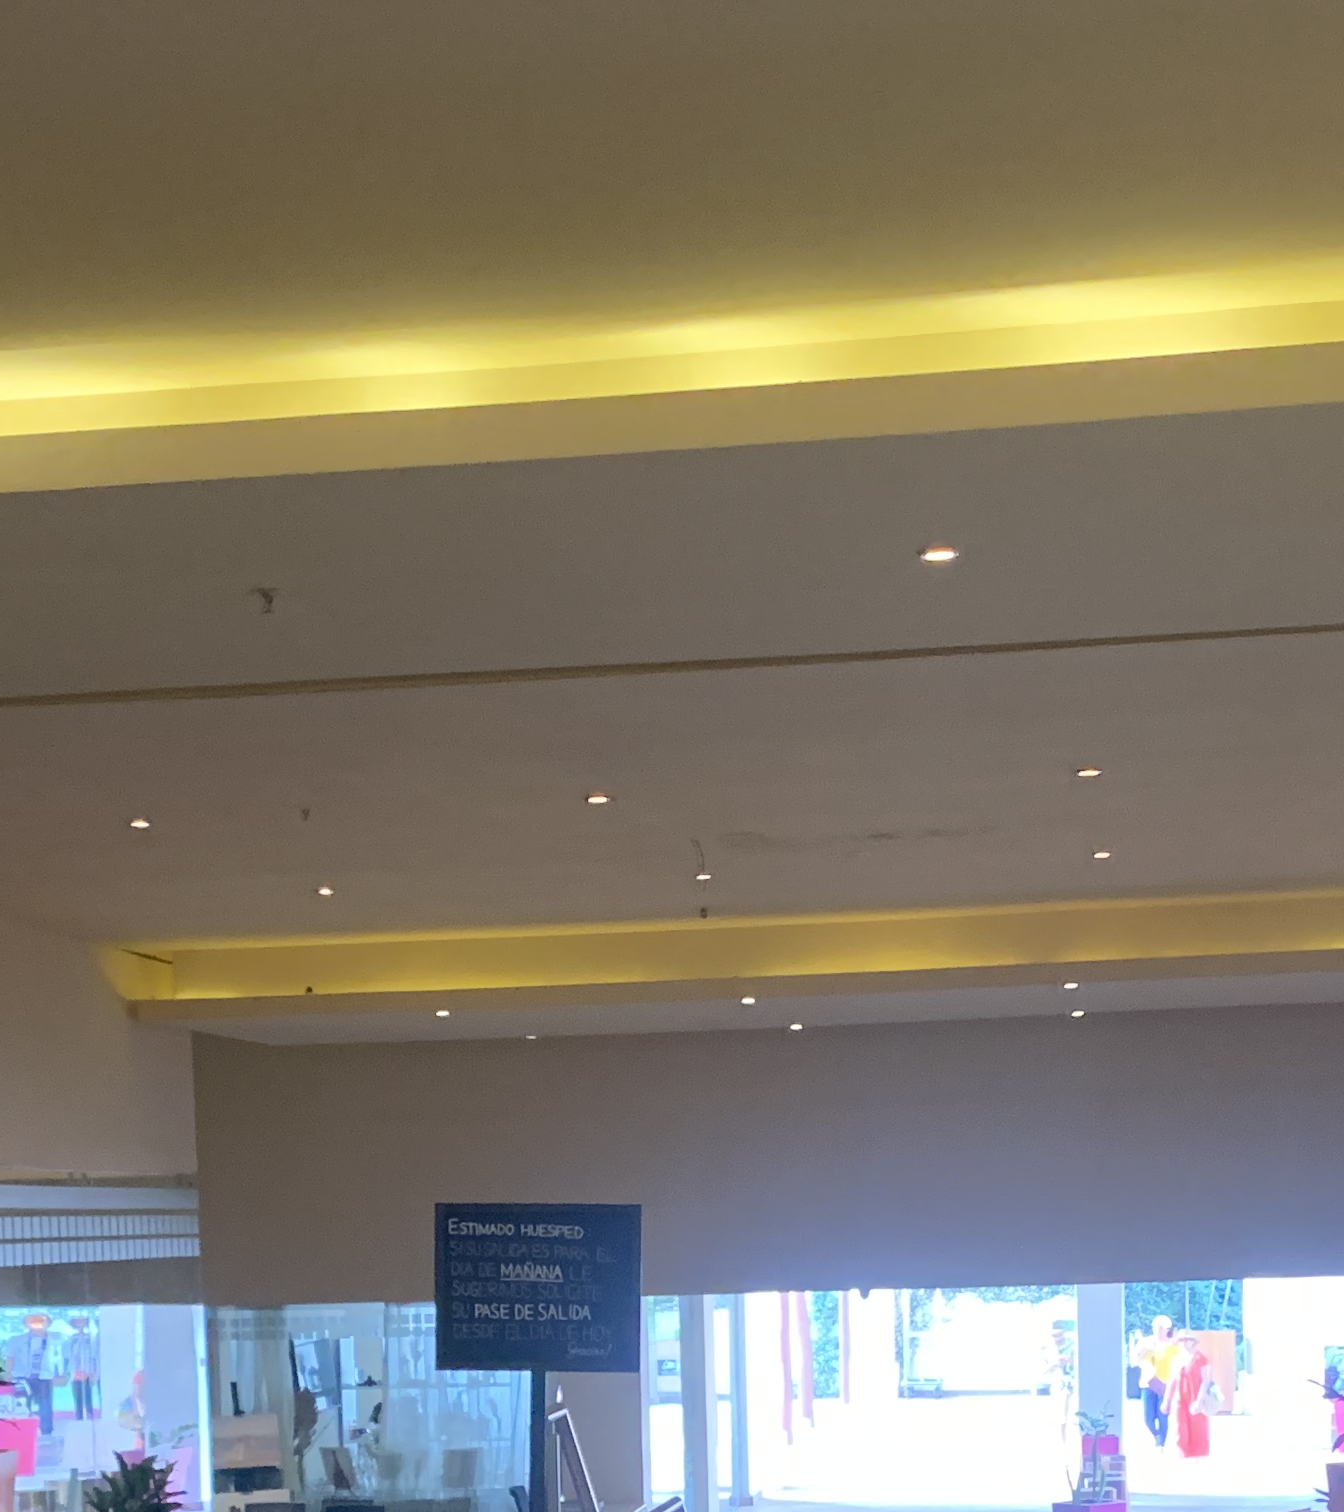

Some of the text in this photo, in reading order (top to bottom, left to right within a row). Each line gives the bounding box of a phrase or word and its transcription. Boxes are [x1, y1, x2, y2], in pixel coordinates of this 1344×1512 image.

[448, 1218, 585, 1239] ESTIMADO HUESPED
[531, 1243, 550, 1258] ES
[554, 1244, 590, 1261] PARA
[500, 1261, 564, 1281] MAÑANA
[474, 1303, 510, 1320] PASE
[514, 1304, 535, 1321] DE
[537, 1303, 592, 1321] SALIDA
